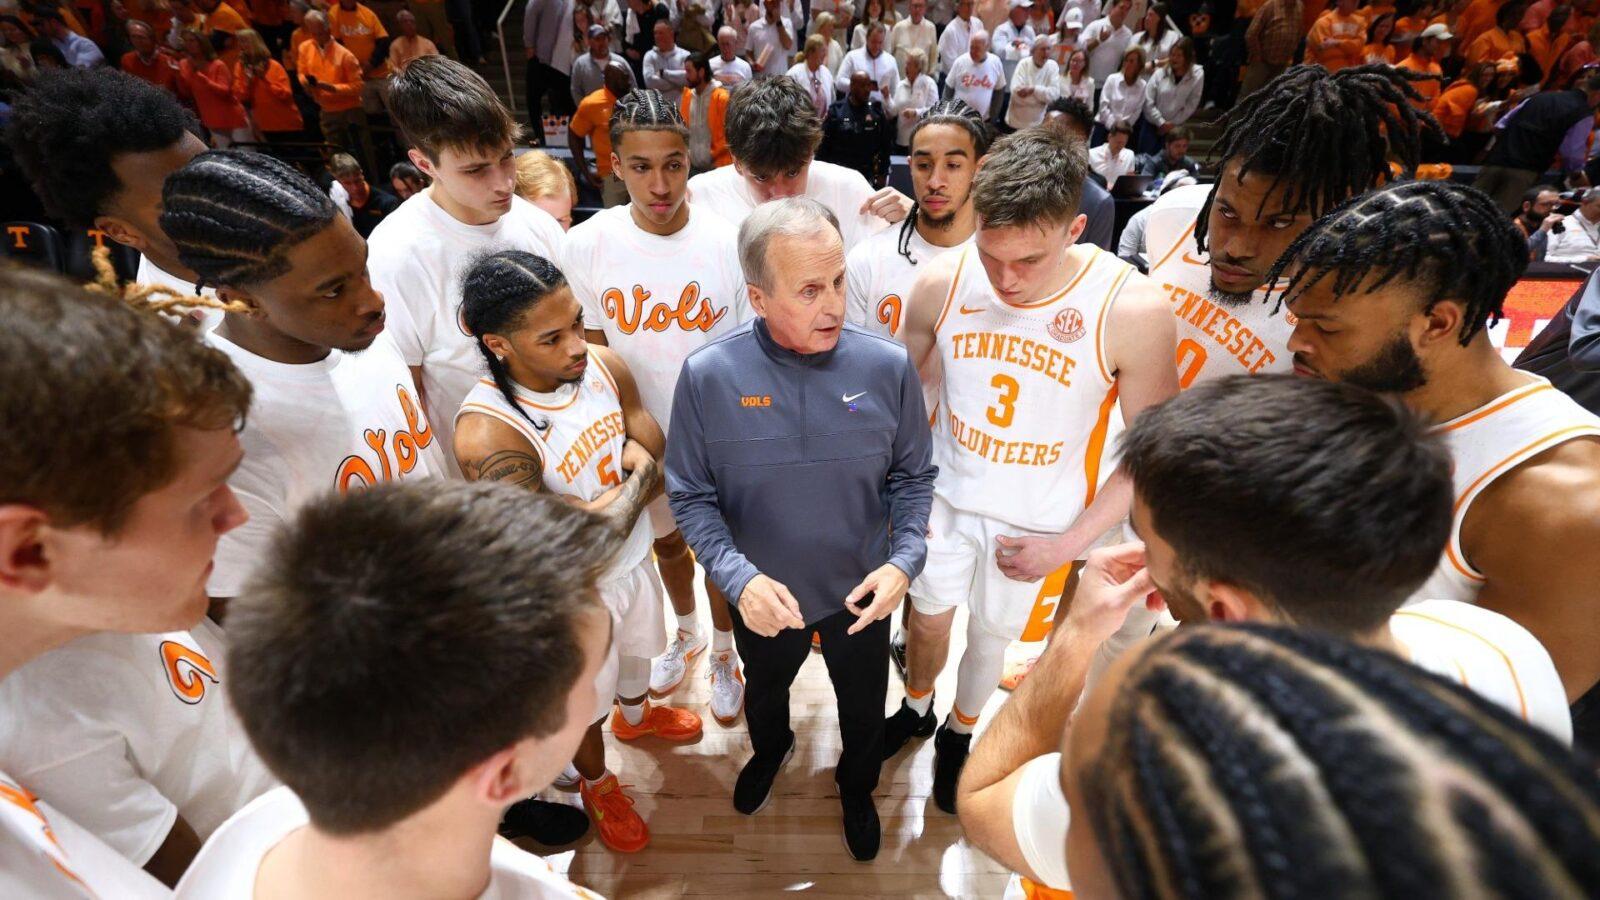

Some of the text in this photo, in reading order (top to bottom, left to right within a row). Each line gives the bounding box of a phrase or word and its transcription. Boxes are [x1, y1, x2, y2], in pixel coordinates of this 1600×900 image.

[7, 226, 30, 249] T
[601, 280, 729, 335] Vols
[1055, 308, 1082, 334] SEC
[1162, 282, 1276, 377] ENNESSEE
[952, 332, 1077, 387] TENNESSEE
[740, 396, 772, 408] VOLS
[986, 373, 1020, 429] 3
[555, 411, 625, 484] TENNESSE
[947, 408, 1065, 467] OLUNTEERS
[596, 452, 622, 487] 5
